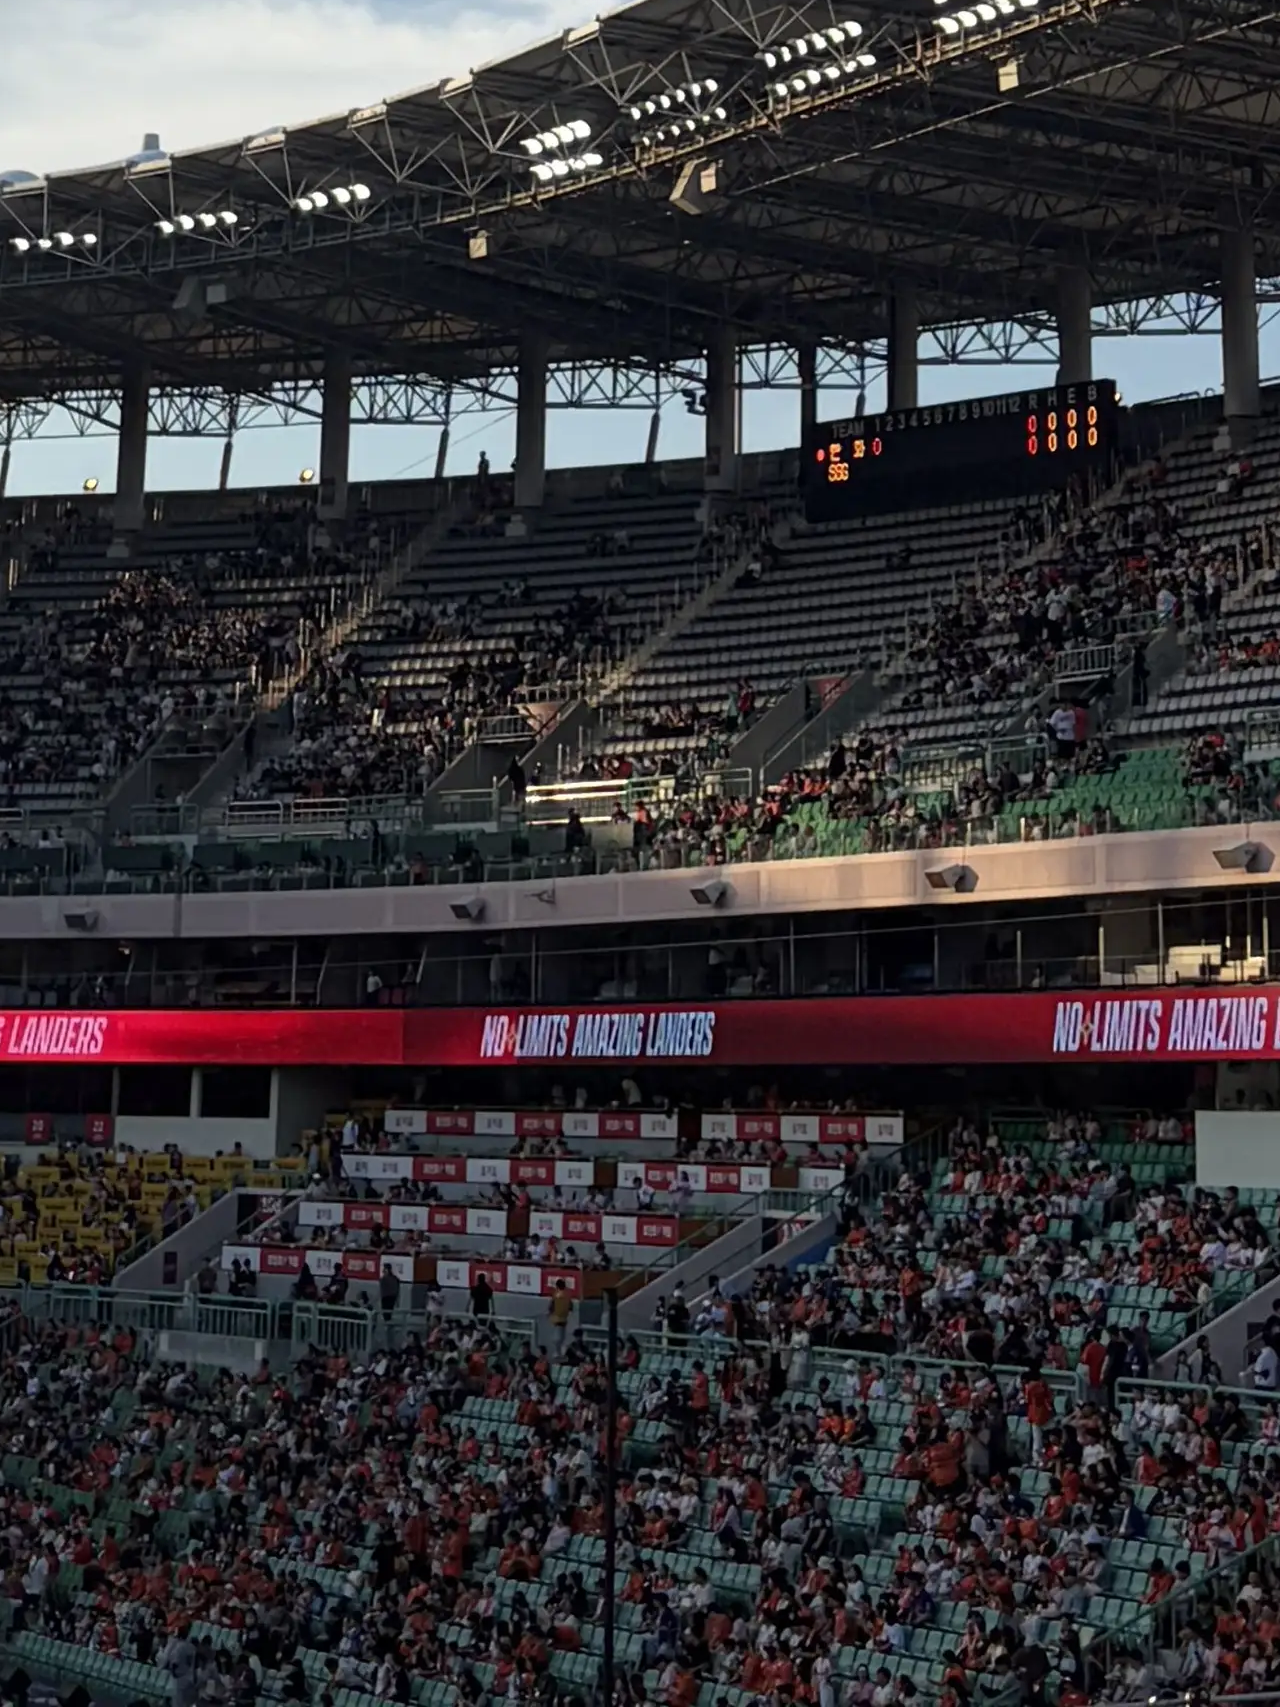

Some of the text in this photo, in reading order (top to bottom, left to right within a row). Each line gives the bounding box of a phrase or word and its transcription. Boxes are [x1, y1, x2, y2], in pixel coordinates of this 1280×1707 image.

[832, 419, 865, 439] TEAM
[885, 415, 894, 432] 2
[897, 413, 906, 429] 3
[909, 411, 919, 427] 4
[922, 409, 932, 426] 5
[935, 407, 944, 424] 6
[947, 406, 955, 422] 7
[959, 403, 968, 420] 8
[972, 401, 981, 419] 9
[982, 400, 995, 417] 10
[1008, 396, 1021, 414] 12
[1028, 393, 1038, 410] R
[1048, 390, 1058, 407] H
[1067, 388, 1077, 404] E
[1087, 385, 1097, 402] B
[872, 437, 882, 456] 0
[1028, 414, 1038, 433] 0
[1048, 411, 1057, 430] 0
[1067, 408, 1077, 428] 0
[1087, 405, 1097, 425] 0
[1028, 435, 1038, 455] 0
[1048, 432, 1058, 452] 0
[1067, 429, 1077, 449] 0
[1088, 426, 1098, 446] 0
[7, 1015, 108, 1054] LANDERS
[480, 1011, 715, 1057] NO LIMITS AMAZING LANDERS
[1053, 1001, 1084, 1052] NO
[1090, 999, 1163, 1052] LIMITS
[1167, 997, 1268, 1051] AMAZING
